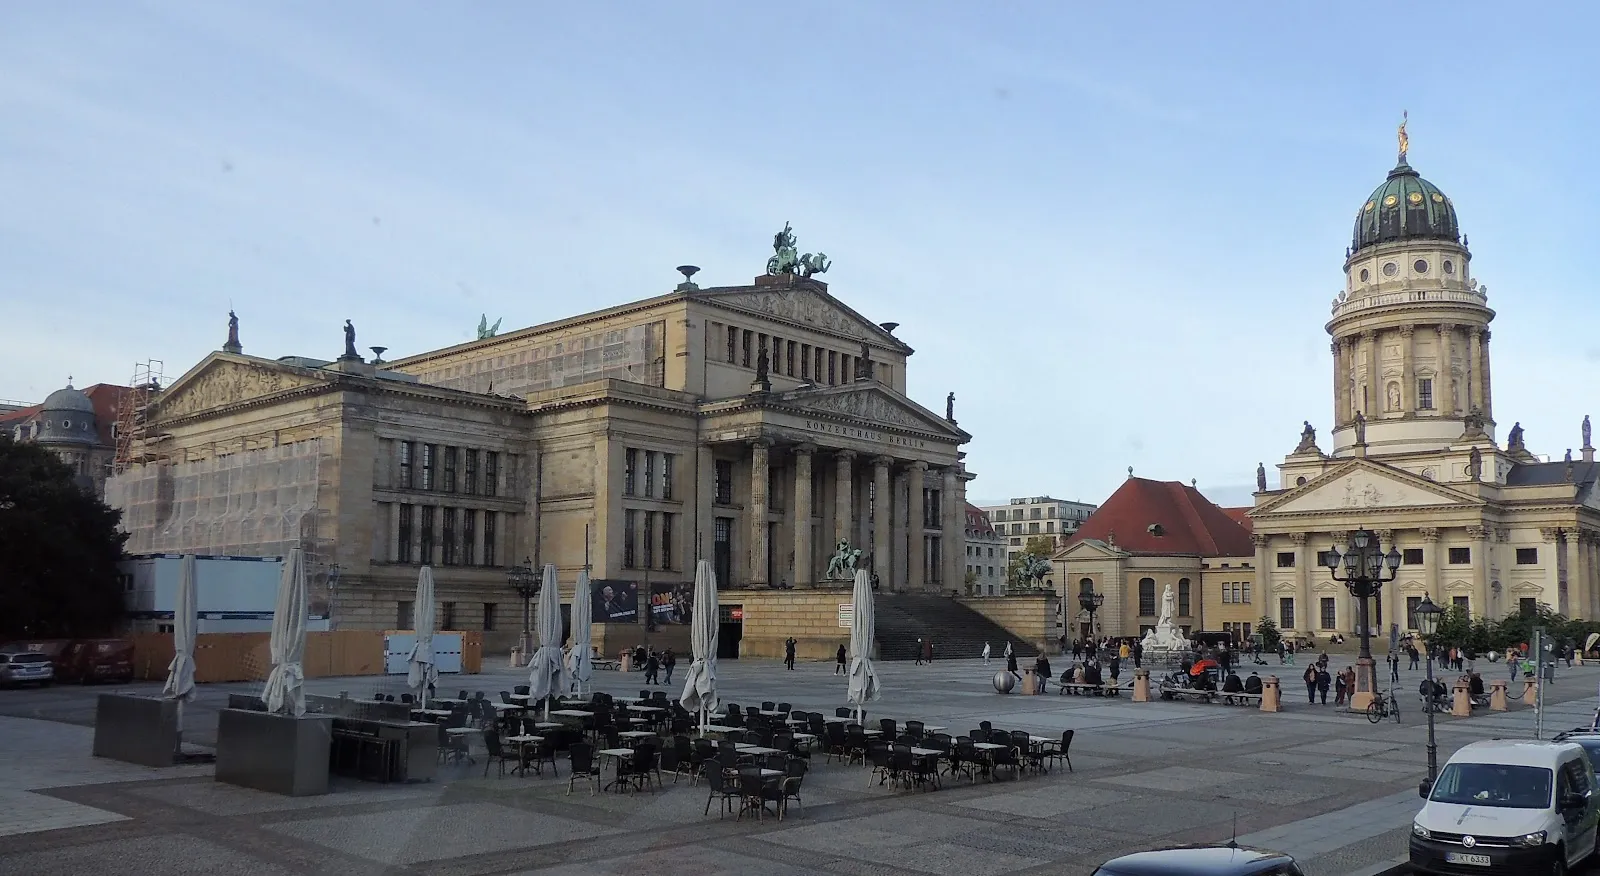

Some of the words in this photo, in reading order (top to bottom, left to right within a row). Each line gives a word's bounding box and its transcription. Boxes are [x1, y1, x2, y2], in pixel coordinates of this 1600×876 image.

[806, 420, 882, 441] KONZERTHAUS
[889, 435, 924, 448] BERLIN
[1470, 856, 1489, 864] 6333
